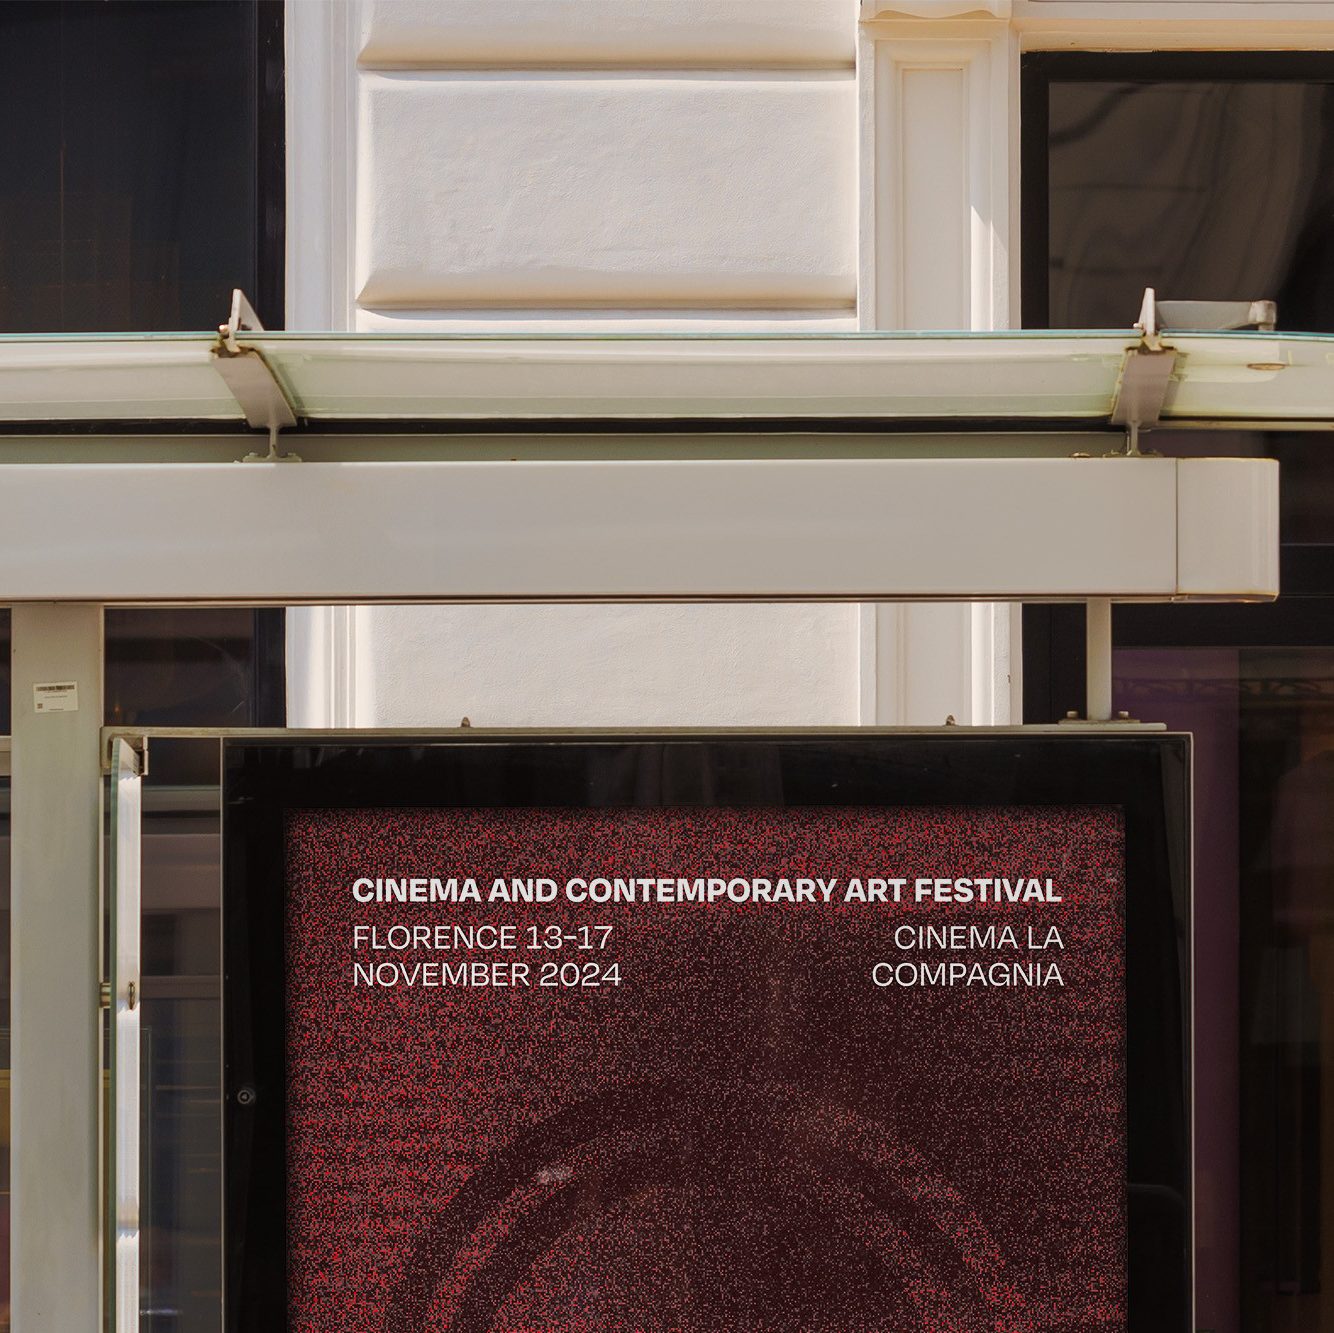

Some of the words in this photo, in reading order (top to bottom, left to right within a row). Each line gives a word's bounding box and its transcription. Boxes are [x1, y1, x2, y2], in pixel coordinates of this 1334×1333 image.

[353, 878, 481, 902] CINEMA
[488, 878, 558, 902] AND
[566, 878, 837, 902] CONTEMPORARY
[844, 878, 907, 902] ART
[916, 878, 1062, 902] FESTIVAL
[354, 926, 516, 949] FLORENCE
[527, 926, 613, 949] 13-17
[894, 926, 1019, 949] CINEMA
[1028, 926, 1065, 949] LA
[354, 963, 530, 986] NOVEMBER
[540, 963, 622, 986] 2024
[872, 963, 1065, 986] COMPAGNIA
